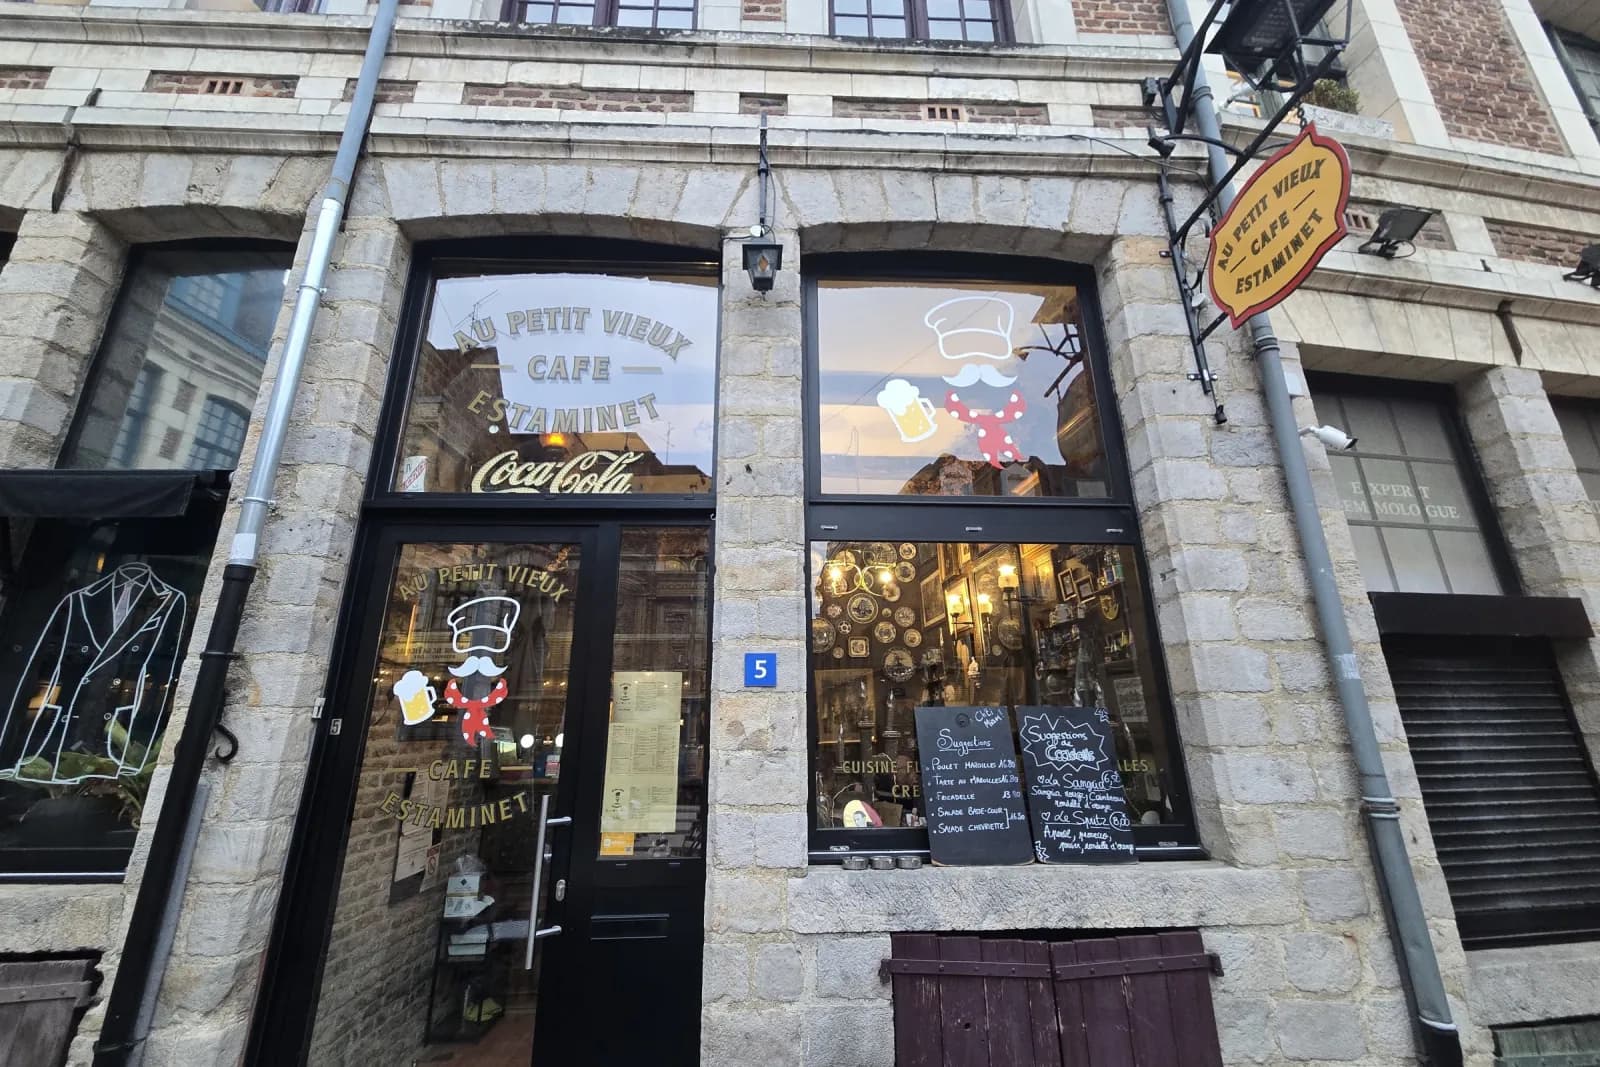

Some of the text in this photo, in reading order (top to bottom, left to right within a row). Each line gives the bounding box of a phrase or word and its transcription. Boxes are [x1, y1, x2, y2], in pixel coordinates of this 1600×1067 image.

[1217, 158, 1327, 271] AU PETIT VIEUX
[1250, 210, 1291, 256] CAFE
[1235, 208, 1324, 295] ESTAMINET
[453, 306, 694, 362] AU PETIT VIEUX
[527, 354, 612, 383] CAFE
[466, 389, 660, 434] ESTAMINET
[1351, 481, 1432, 500] EXPERT
[1343, 499, 1461, 519] EMMOLOGUE
[399, 563, 570, 603] AU PETIT VIEUX
[754, 659, 767, 679] 5
[936, 728, 992, 757] Suggestions
[1027, 725, 1089, 746] Suggestions
[428, 759, 493, 781] CAFE
[842, 760, 898, 774] CUISINE
[379, 790, 529, 830] ESTAMINET
